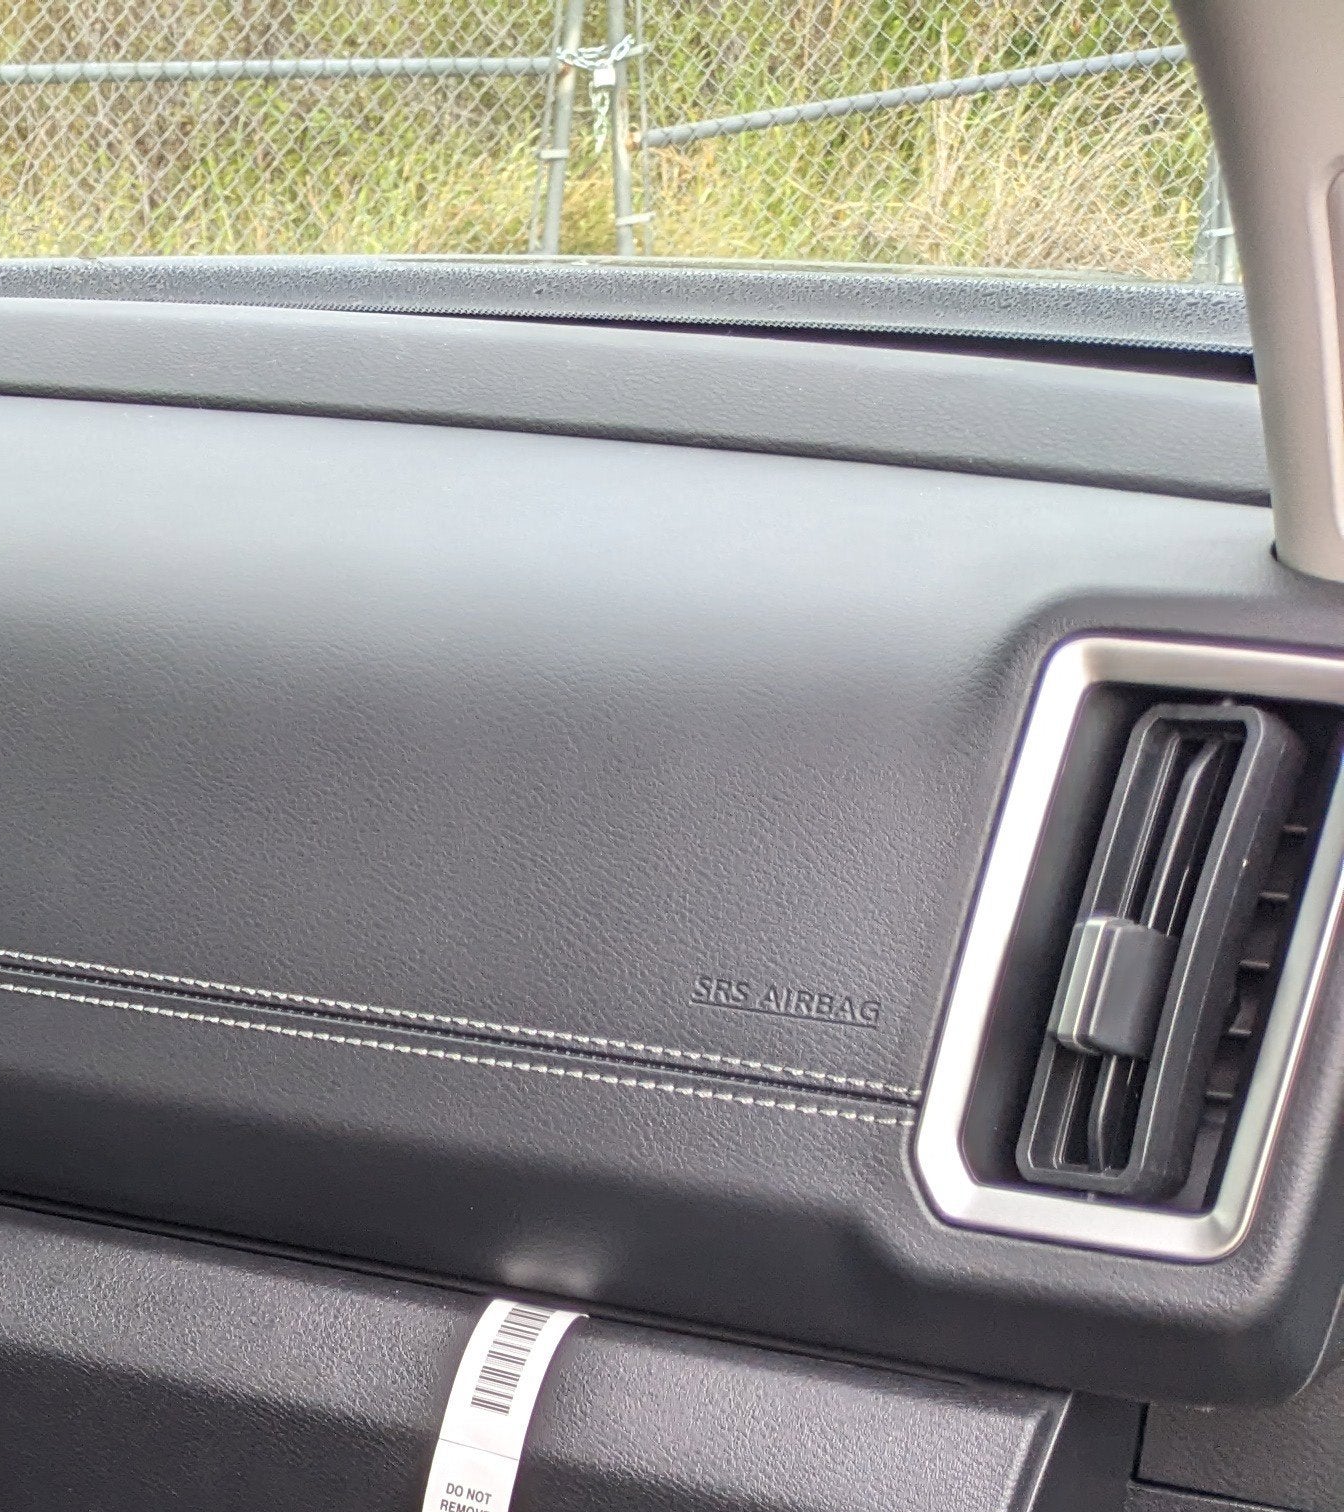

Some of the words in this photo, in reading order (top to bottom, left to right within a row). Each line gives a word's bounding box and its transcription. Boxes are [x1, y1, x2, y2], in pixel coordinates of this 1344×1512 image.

[691, 976, 751, 1004] SRS
[758, 984, 883, 1024] AIRBAG
[446, 1483, 463, 1497] DO
[467, 1488, 492, 1505] NOT
